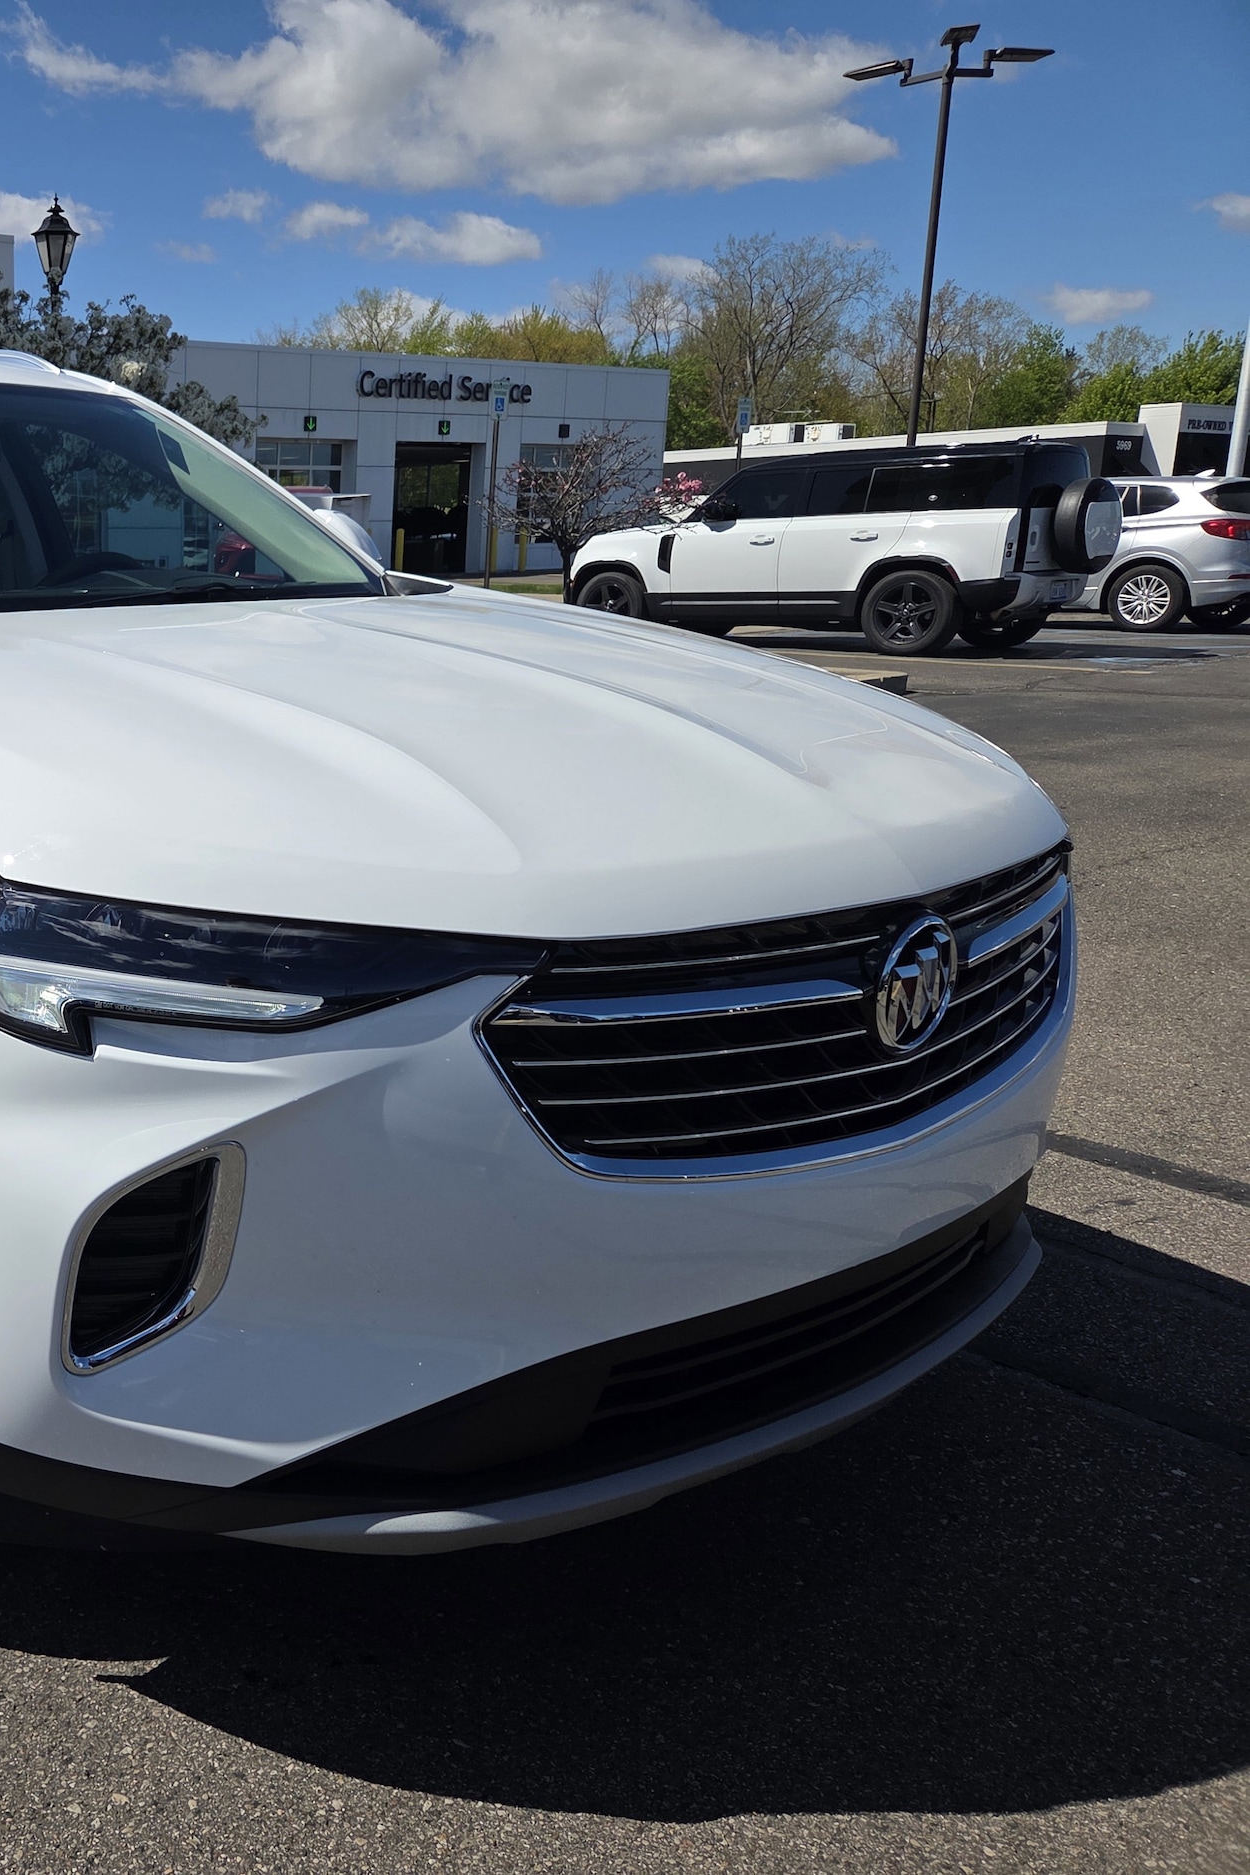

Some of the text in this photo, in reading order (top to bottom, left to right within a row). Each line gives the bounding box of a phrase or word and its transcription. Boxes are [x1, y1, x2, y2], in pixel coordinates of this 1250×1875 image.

[358, 370, 533, 404] Certified Serce
[1187, 419, 1227, 431] PRE-OWNED
[1116, 440, 1132, 450] 5969
